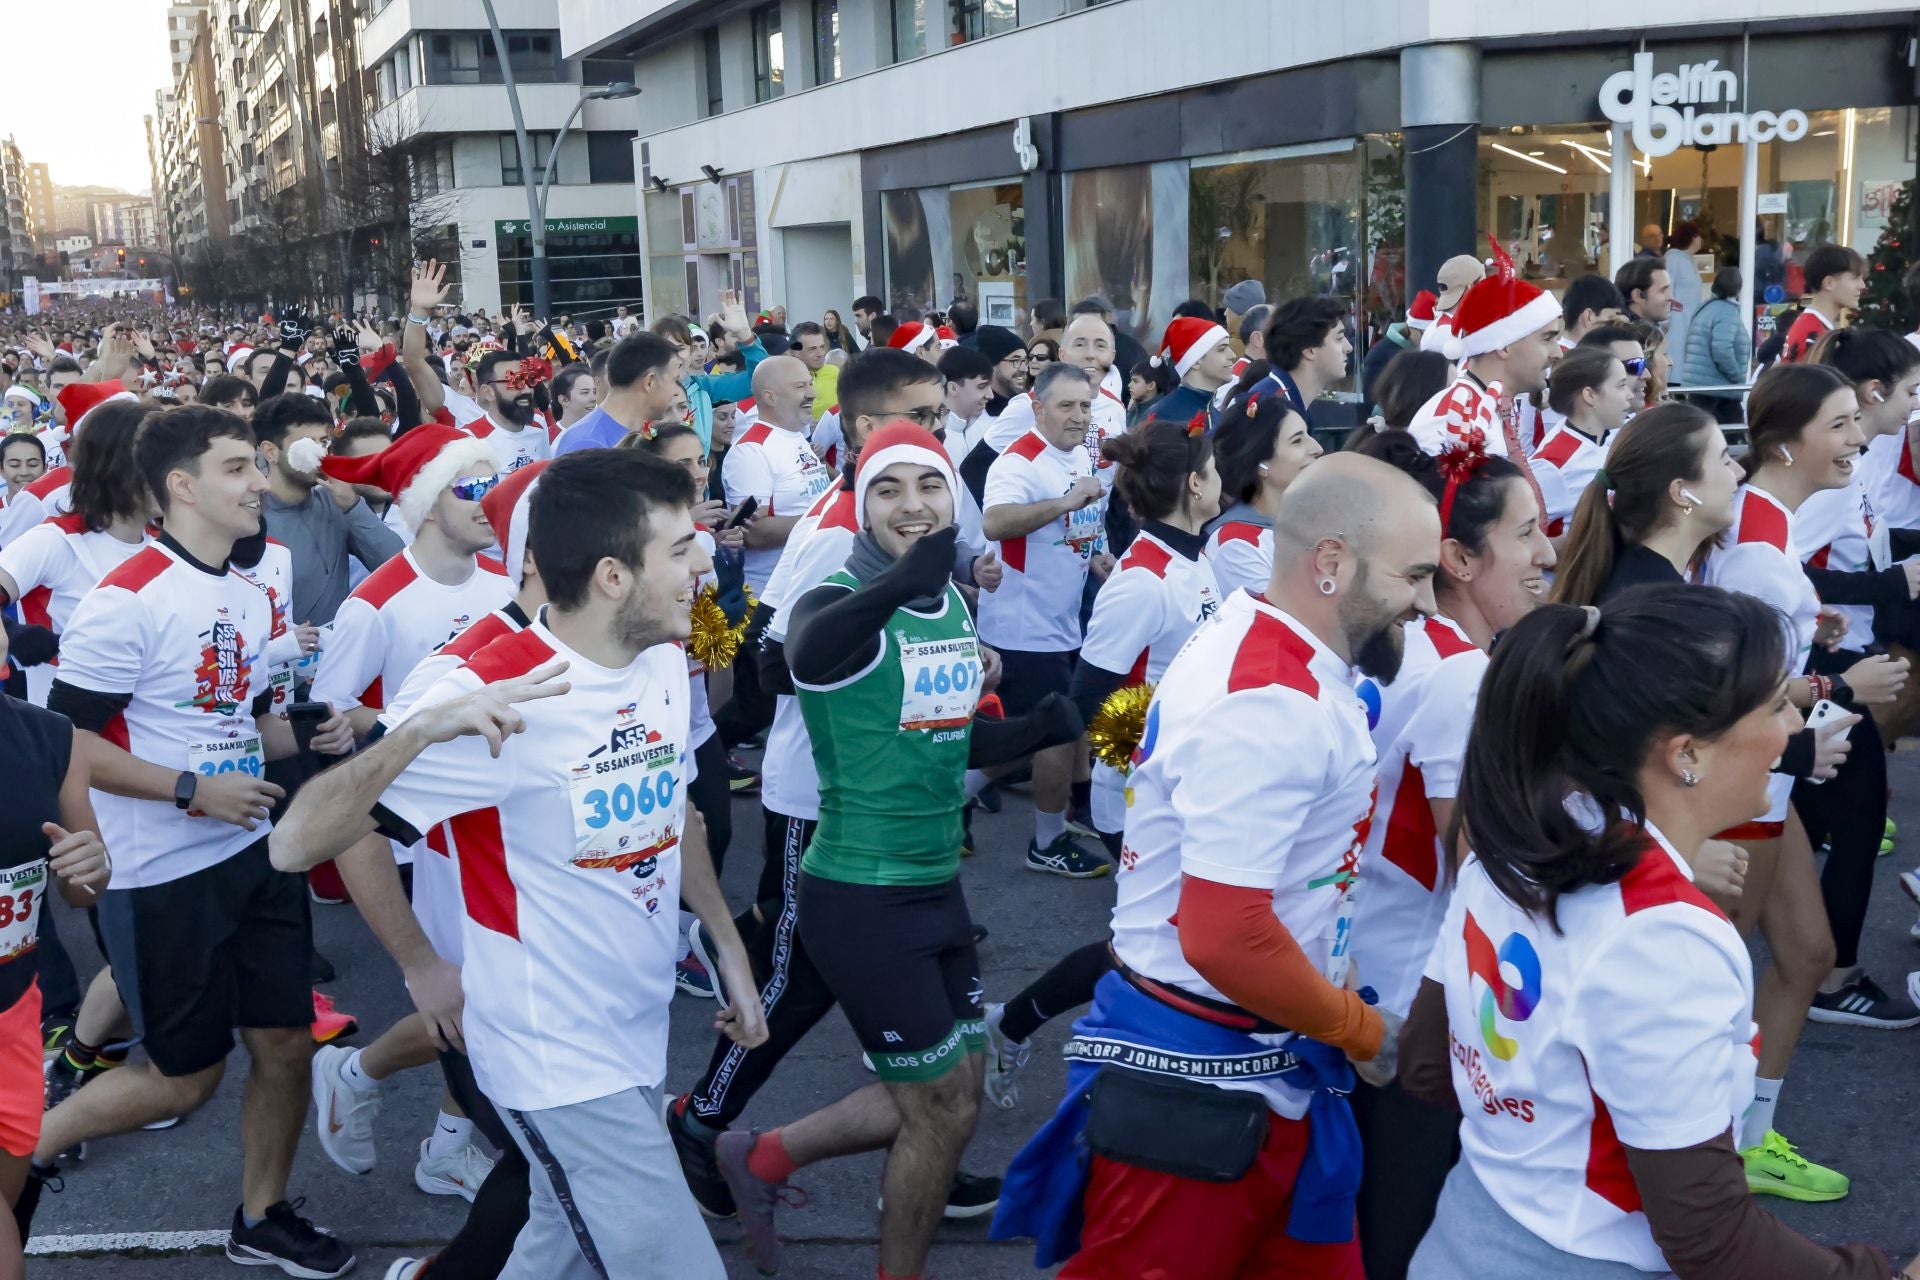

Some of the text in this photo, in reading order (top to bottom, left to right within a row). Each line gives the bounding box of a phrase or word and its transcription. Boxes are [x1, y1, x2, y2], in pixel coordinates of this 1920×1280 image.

[1632, 104, 1809, 157] blanco
[523, 219, 606, 232] Cro Asistencial
[223, 625, 236, 639] 55
[918, 647, 929, 656] 55
[930, 644, 947, 655] SAN
[218, 651, 238, 668] SIL
[219, 668, 238, 685] VES
[914, 661, 977, 696] 4607
[206, 744, 218, 752] 55
[219, 742, 235, 751] SAN
[596, 762, 610, 774] 55
[611, 755, 630, 771] SAN
[631, 743, 675, 766] SILVESTRE
[583, 770, 674, 829] 3060
[0, 864, 42, 884] ILVESTRE
[0, 889, 34, 928] 83
[888, 1057, 919, 1067] LOS
[1124, 1049, 1170, 1070] JOHN
[1179, 1060, 1233, 1075] SMITH
